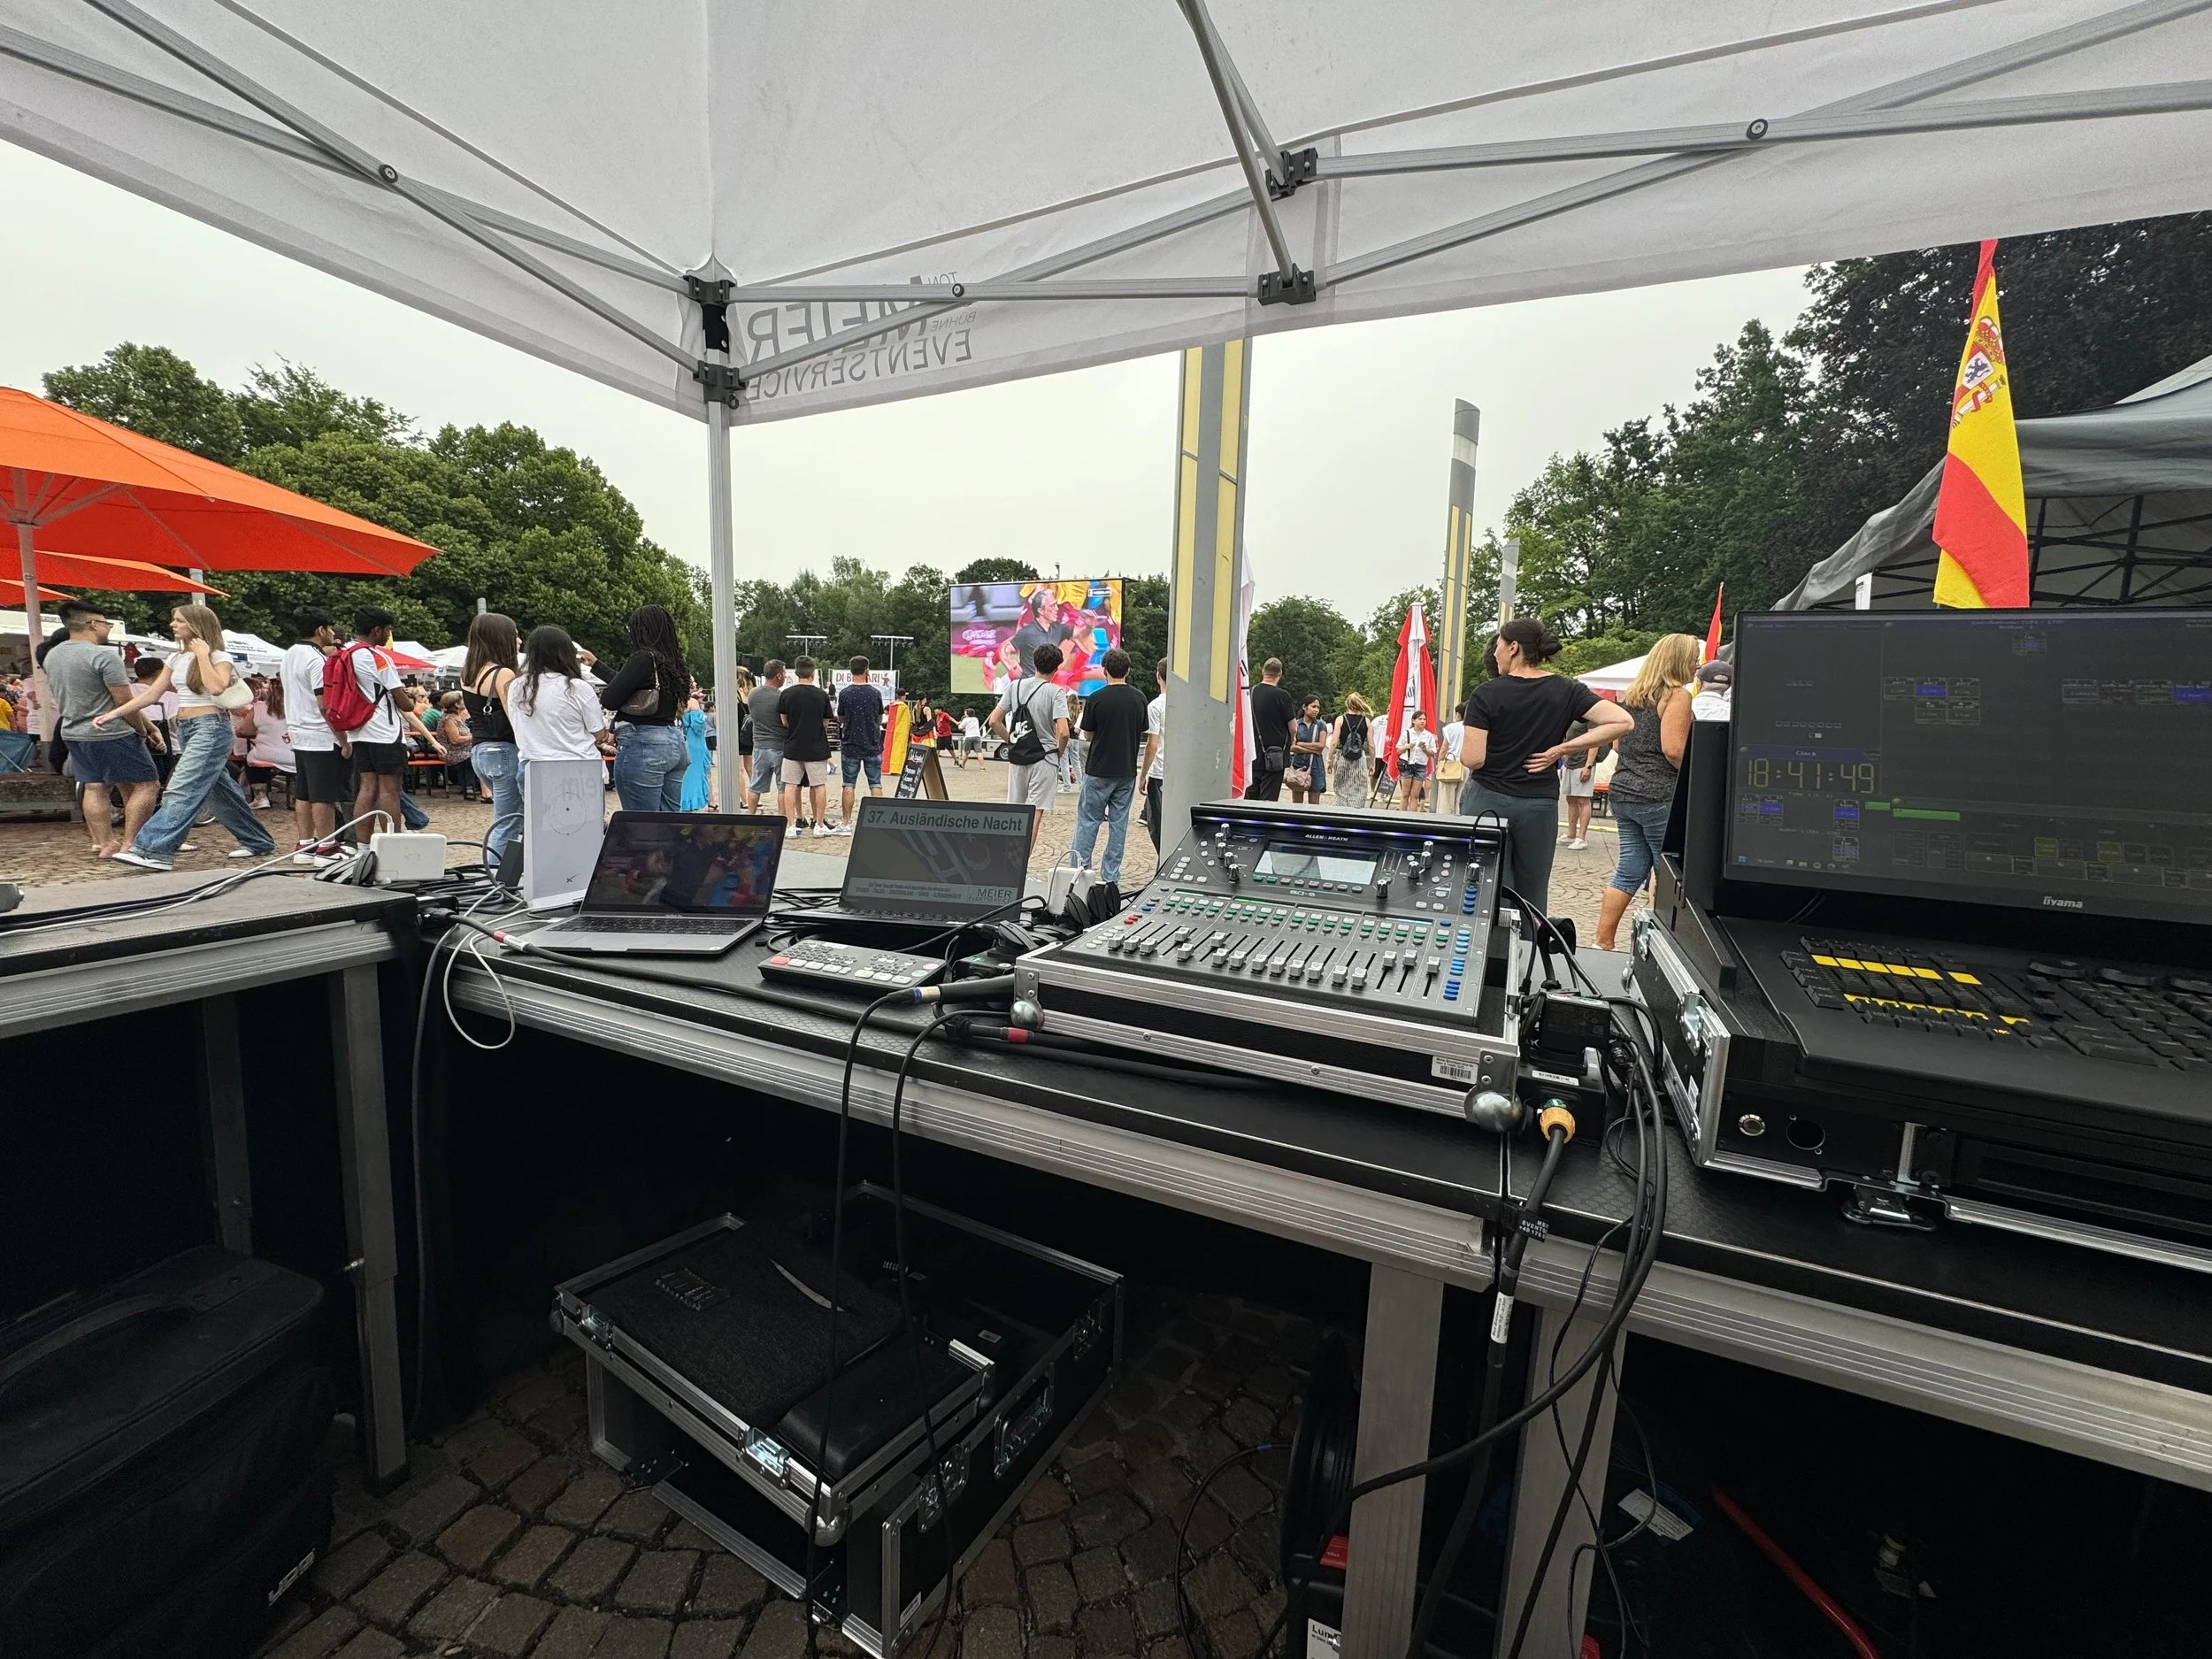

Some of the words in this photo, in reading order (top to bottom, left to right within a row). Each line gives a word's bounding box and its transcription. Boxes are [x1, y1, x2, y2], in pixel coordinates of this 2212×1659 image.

[836, 672, 844, 682] DI
[867, 810, 886, 824] 37.
[889, 811, 979, 829] Ausländische
[983, 816, 1023, 832] Nacht
[977, 888, 1012, 900] MEIER
[2042, 895, 2084, 909] iiyama
